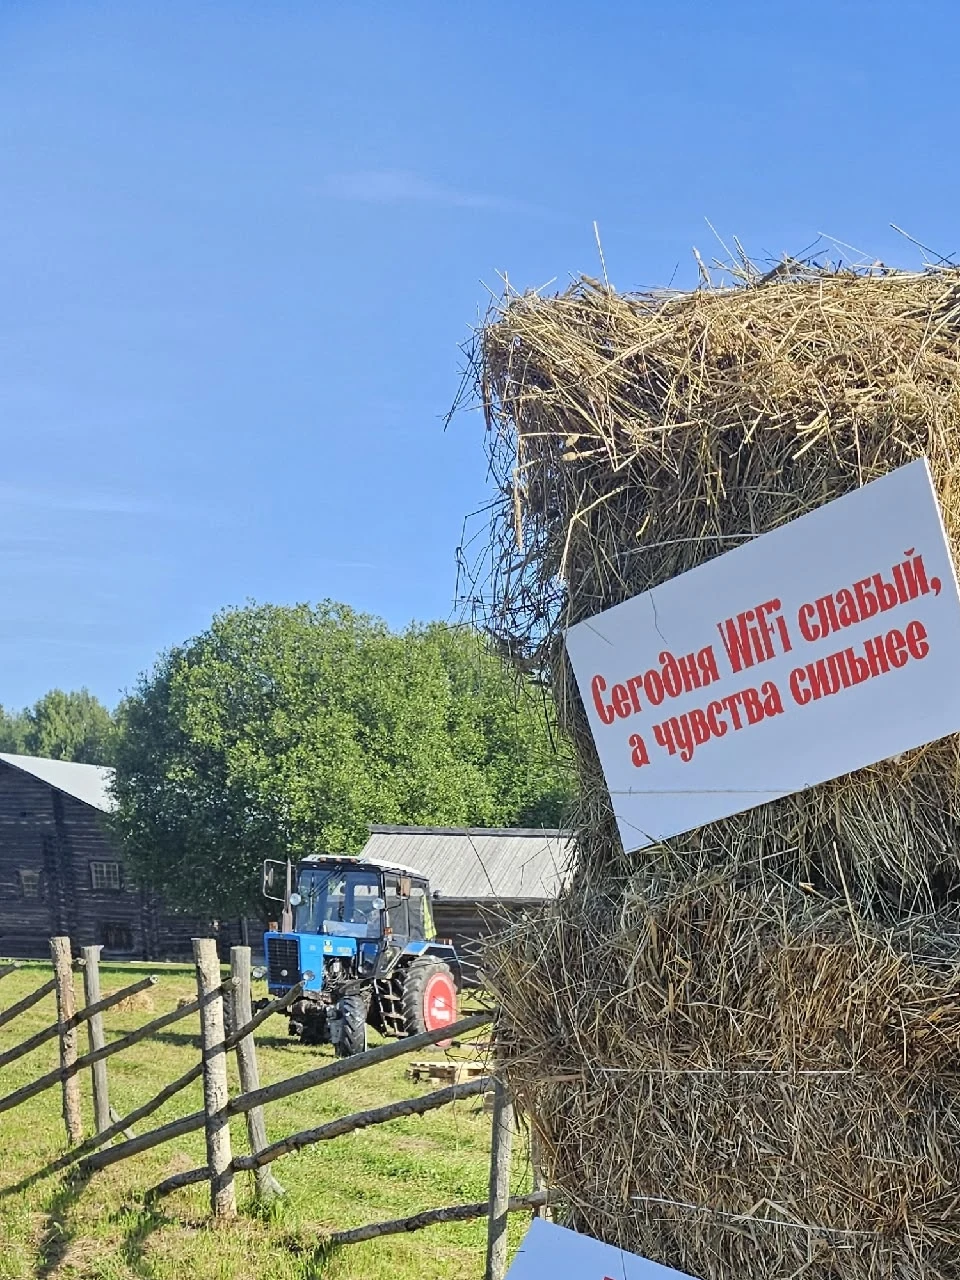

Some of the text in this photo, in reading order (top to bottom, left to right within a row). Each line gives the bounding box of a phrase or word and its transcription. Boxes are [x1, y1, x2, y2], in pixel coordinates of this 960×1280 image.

[590, 546, 943, 726] Сегодня WiFi слабый,
[628, 620, 930, 768] а чувства сильнее
